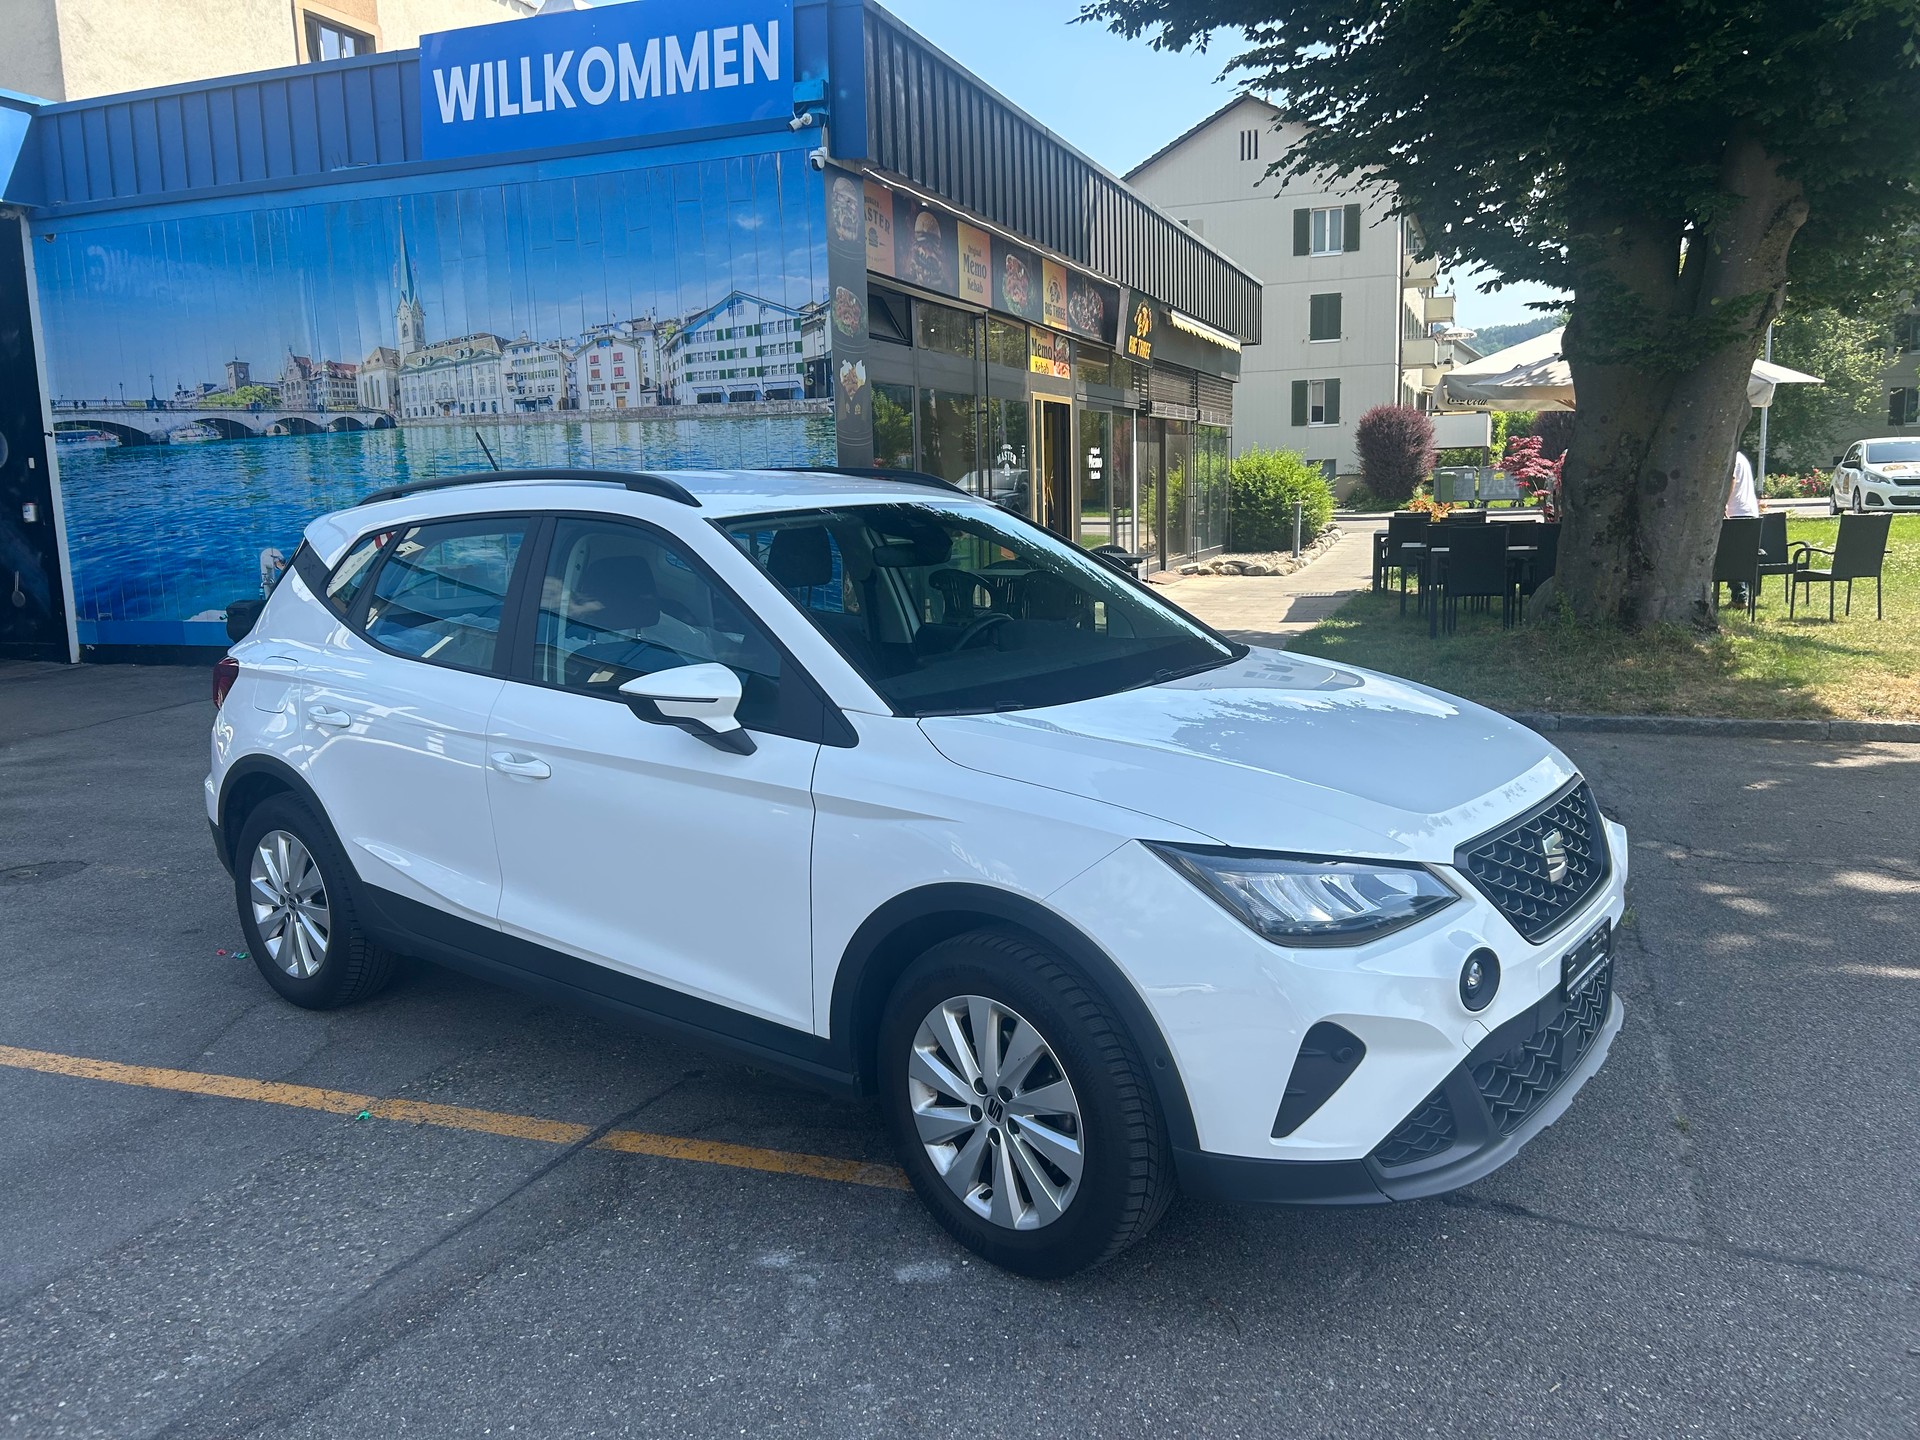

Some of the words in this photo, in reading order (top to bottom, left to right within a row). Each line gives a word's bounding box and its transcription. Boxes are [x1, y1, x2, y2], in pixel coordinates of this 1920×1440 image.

[432, 20, 779, 124] WILLKOMMEN
[963, 252, 987, 280] Memo
[967, 277, 983, 294] Kebab
[1044, 302, 1053, 316] BIG
[1053, 304, 1066, 321] THREE
[1031, 337, 1053, 360] Memo
[1035, 361, 1050, 375] Kebab
[996, 450, 1017, 466] MASTER
